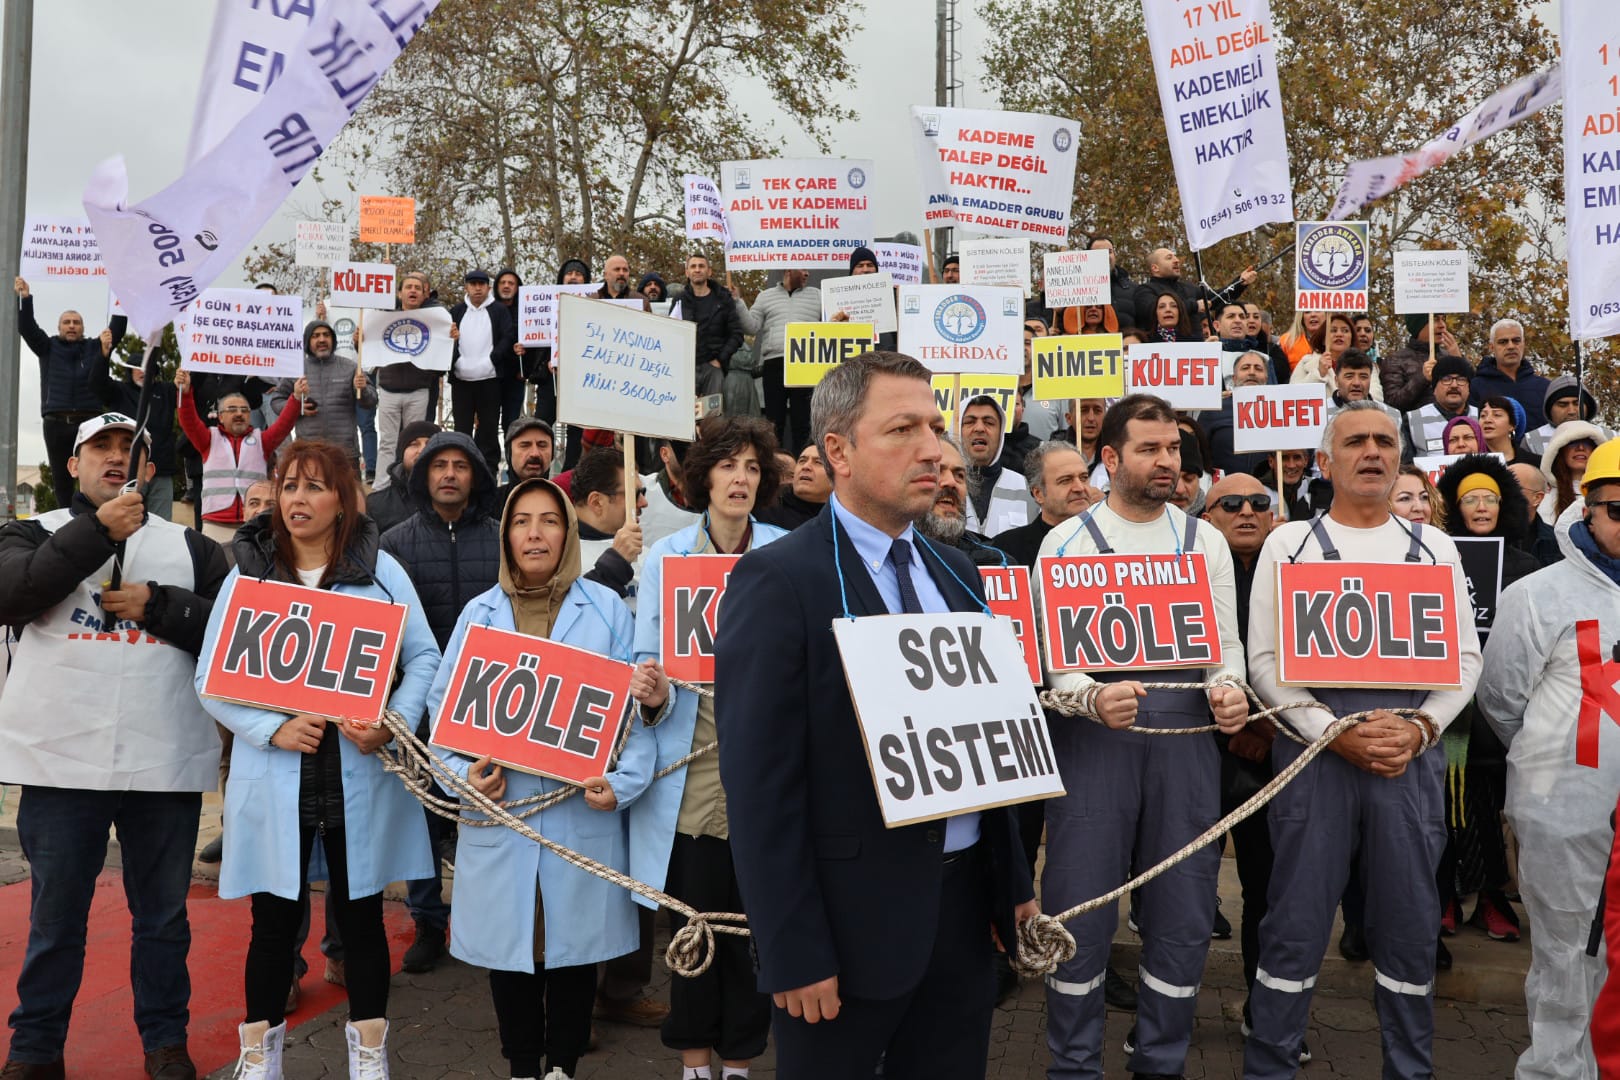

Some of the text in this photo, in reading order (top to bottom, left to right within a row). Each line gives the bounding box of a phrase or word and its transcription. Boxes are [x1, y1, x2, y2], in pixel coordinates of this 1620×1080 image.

[1184, 0, 1241, 28] 17 YIL
[1170, 22, 1270, 68] ADİL DEĞİL
[1174, 54, 1263, 102] KADEMELİ
[1180, 88, 1271, 133] EMEKLİLİK
[958, 128, 1035, 149] KADEME
[1194, 128, 1254, 165] HAKTIR
[938, 148, 1048, 174] TALEP DEĞİL
[762, 177, 837, 192] TEK ÇARE
[950, 171, 1031, 194] HAKTIR...
[730, 196, 867, 212] ADİL VE KADEMELİ
[962, 197, 1022, 214] EMADDER
[1025, 206, 1064, 221] GRUBU
[1235, 200, 1252, 214] 506
[1254, 195, 1268, 206] 19
[1271, 194, 1286, 204] 32
[760, 216, 840, 230] EMEKLİLİK
[976, 215, 1020, 230] ADALET
[1022, 221, 1066, 237] DERNEĞİ
[732, 239, 867, 249] ANKARA EMADDER GRUBU
[730, 251, 788, 263] EMEKLİLİKTE
[790, 253, 828, 262] ADALET
[334, 268, 394, 294] KÜLFET
[196, 299, 293, 316] 1 GÜN 1 AY 1 YIL
[524, 306, 536, 316] İŞE
[1298, 292, 1366, 310] ANKARA
[194, 314, 210, 327] İŞE
[212, 318, 234, 330] GEÇ
[236, 320, 294, 332] BAŞLAYANA
[524, 320, 532, 328] 17
[192, 333, 303, 350] 17 YIL SONRA EMEKLİLİK
[524, 332, 546, 340] ADİL
[613, 328, 662, 352] YAŞINDA
[790, 332, 872, 363] NİMET
[190, 351, 276, 367] ADİL DEĞİL!!!
[582, 345, 636, 367] EMEKLİ
[920, 344, 1008, 360] TEKİRDAĞ
[1038, 346, 1121, 378] NİMET
[1132, 353, 1218, 386] KÜLFET
[1237, 395, 1324, 429] KÜLFET
[1050, 554, 1198, 588] 9000 PRİMLİ
[1057, 592, 1212, 666] KÖLE
[1292, 577, 1447, 660] KÖLE
[222, 602, 386, 698] KÖLE
[898, 626, 999, 691] SGK
[450, 652, 614, 760] KÖLE
[878, 703, 1055, 801] SİSTEMİ
